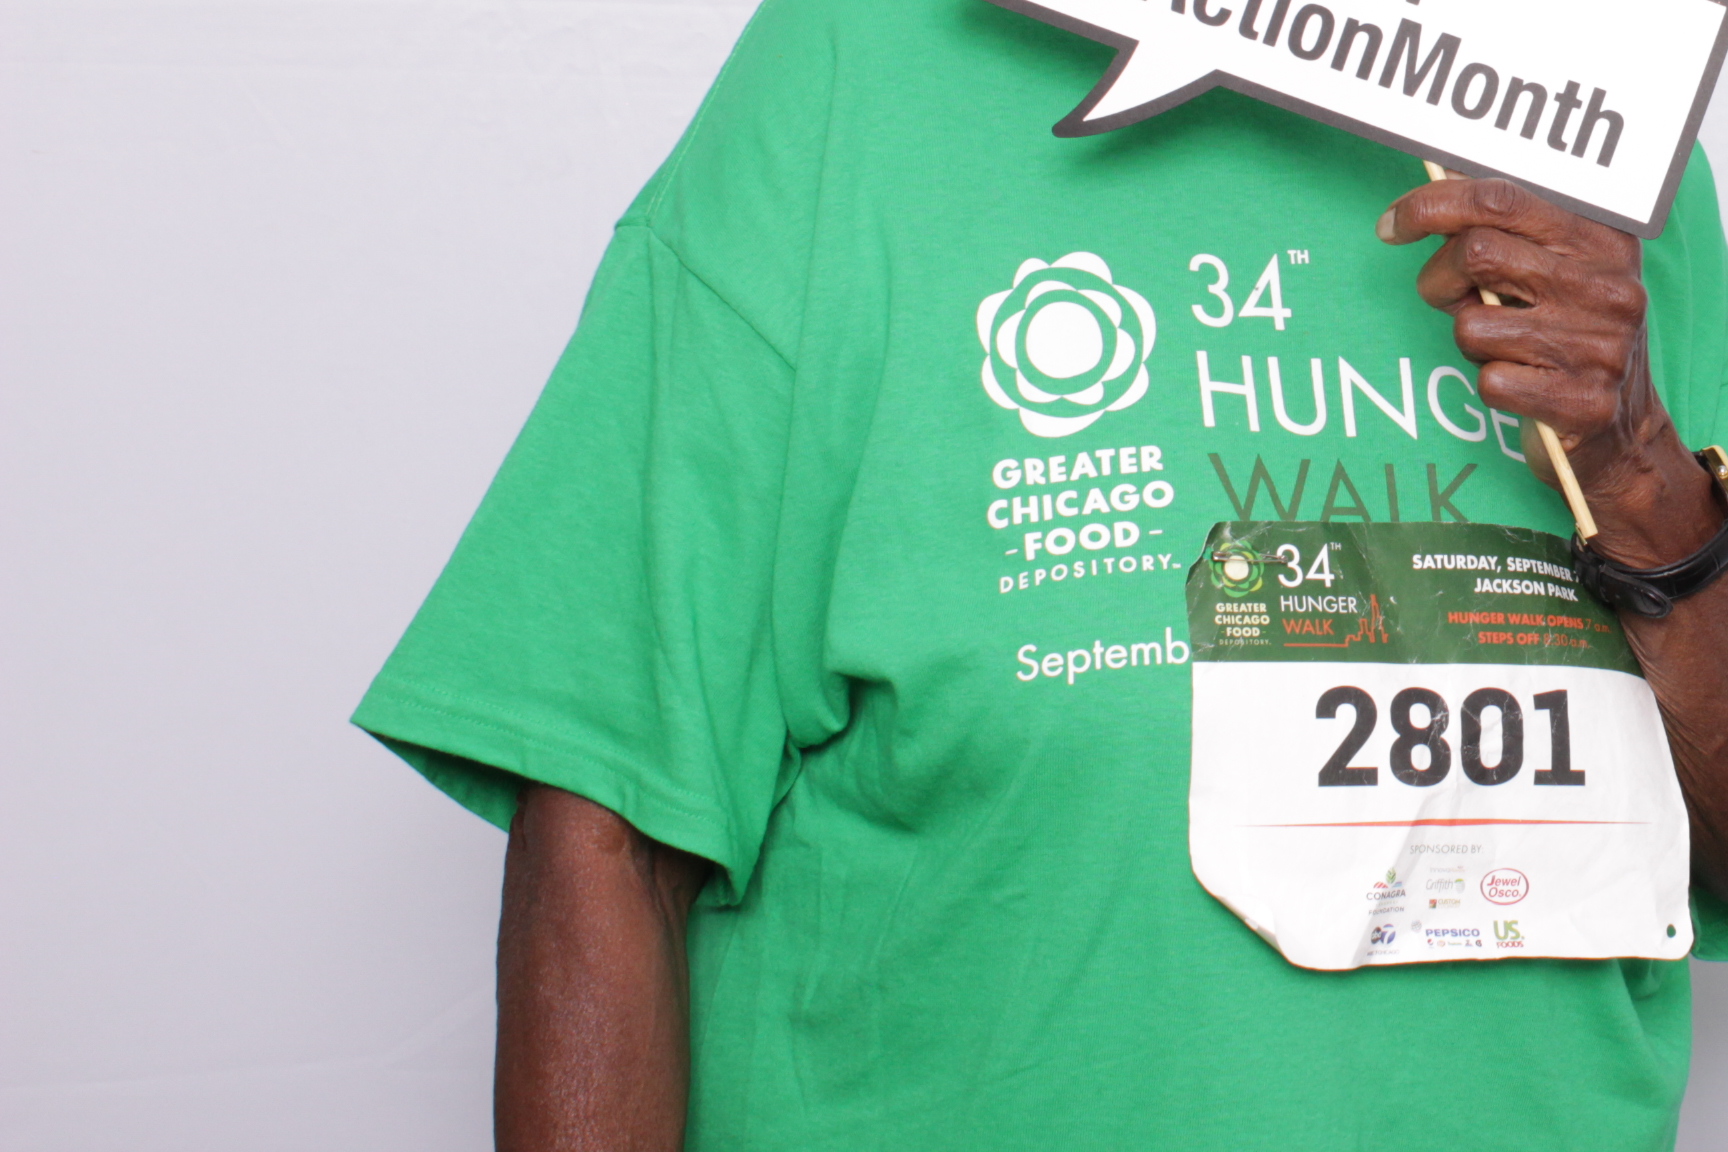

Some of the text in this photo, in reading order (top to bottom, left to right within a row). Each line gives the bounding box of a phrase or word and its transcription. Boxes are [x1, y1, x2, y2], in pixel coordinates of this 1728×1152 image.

[1196, 351, 1528, 464] HUNGE
[992, 445, 1164, 490] GREATER
[986, 480, 1175, 530] CHICAGO
[1412, 554, 1502, 573] SATURDAY,
[1506, 556, 1573, 582] SEPTEMBER
[1474, 578, 1579, 602] JACKSON PARK
[1215, 602, 1267, 613] GREATER
[1280, 595, 1358, 613] HUNGER
[1214, 615, 1271, 625] CHICAGO
[1282, 618, 1335, 635] WALK
[1448, 611, 1506, 625] HUNGER
[1507, 613, 1544, 626] WALK
[1547, 615, 1584, 630] OPENS
[1478, 631, 1515, 644] STEPS
[1516, 632, 1541, 645] OFF
[1016, 626, 1190, 685] Septemb
[1315, 685, 1586, 787] 2801
[1409, 844, 1469, 855] SPONSORED
[1487, 875, 1522, 888] Jewel
[1366, 889, 1407, 901] CONAGRA
[1488, 886, 1520, 899] Osco
[1425, 928, 1481, 938] PEPSICO
[1496, 940, 1524, 949] FOODS
